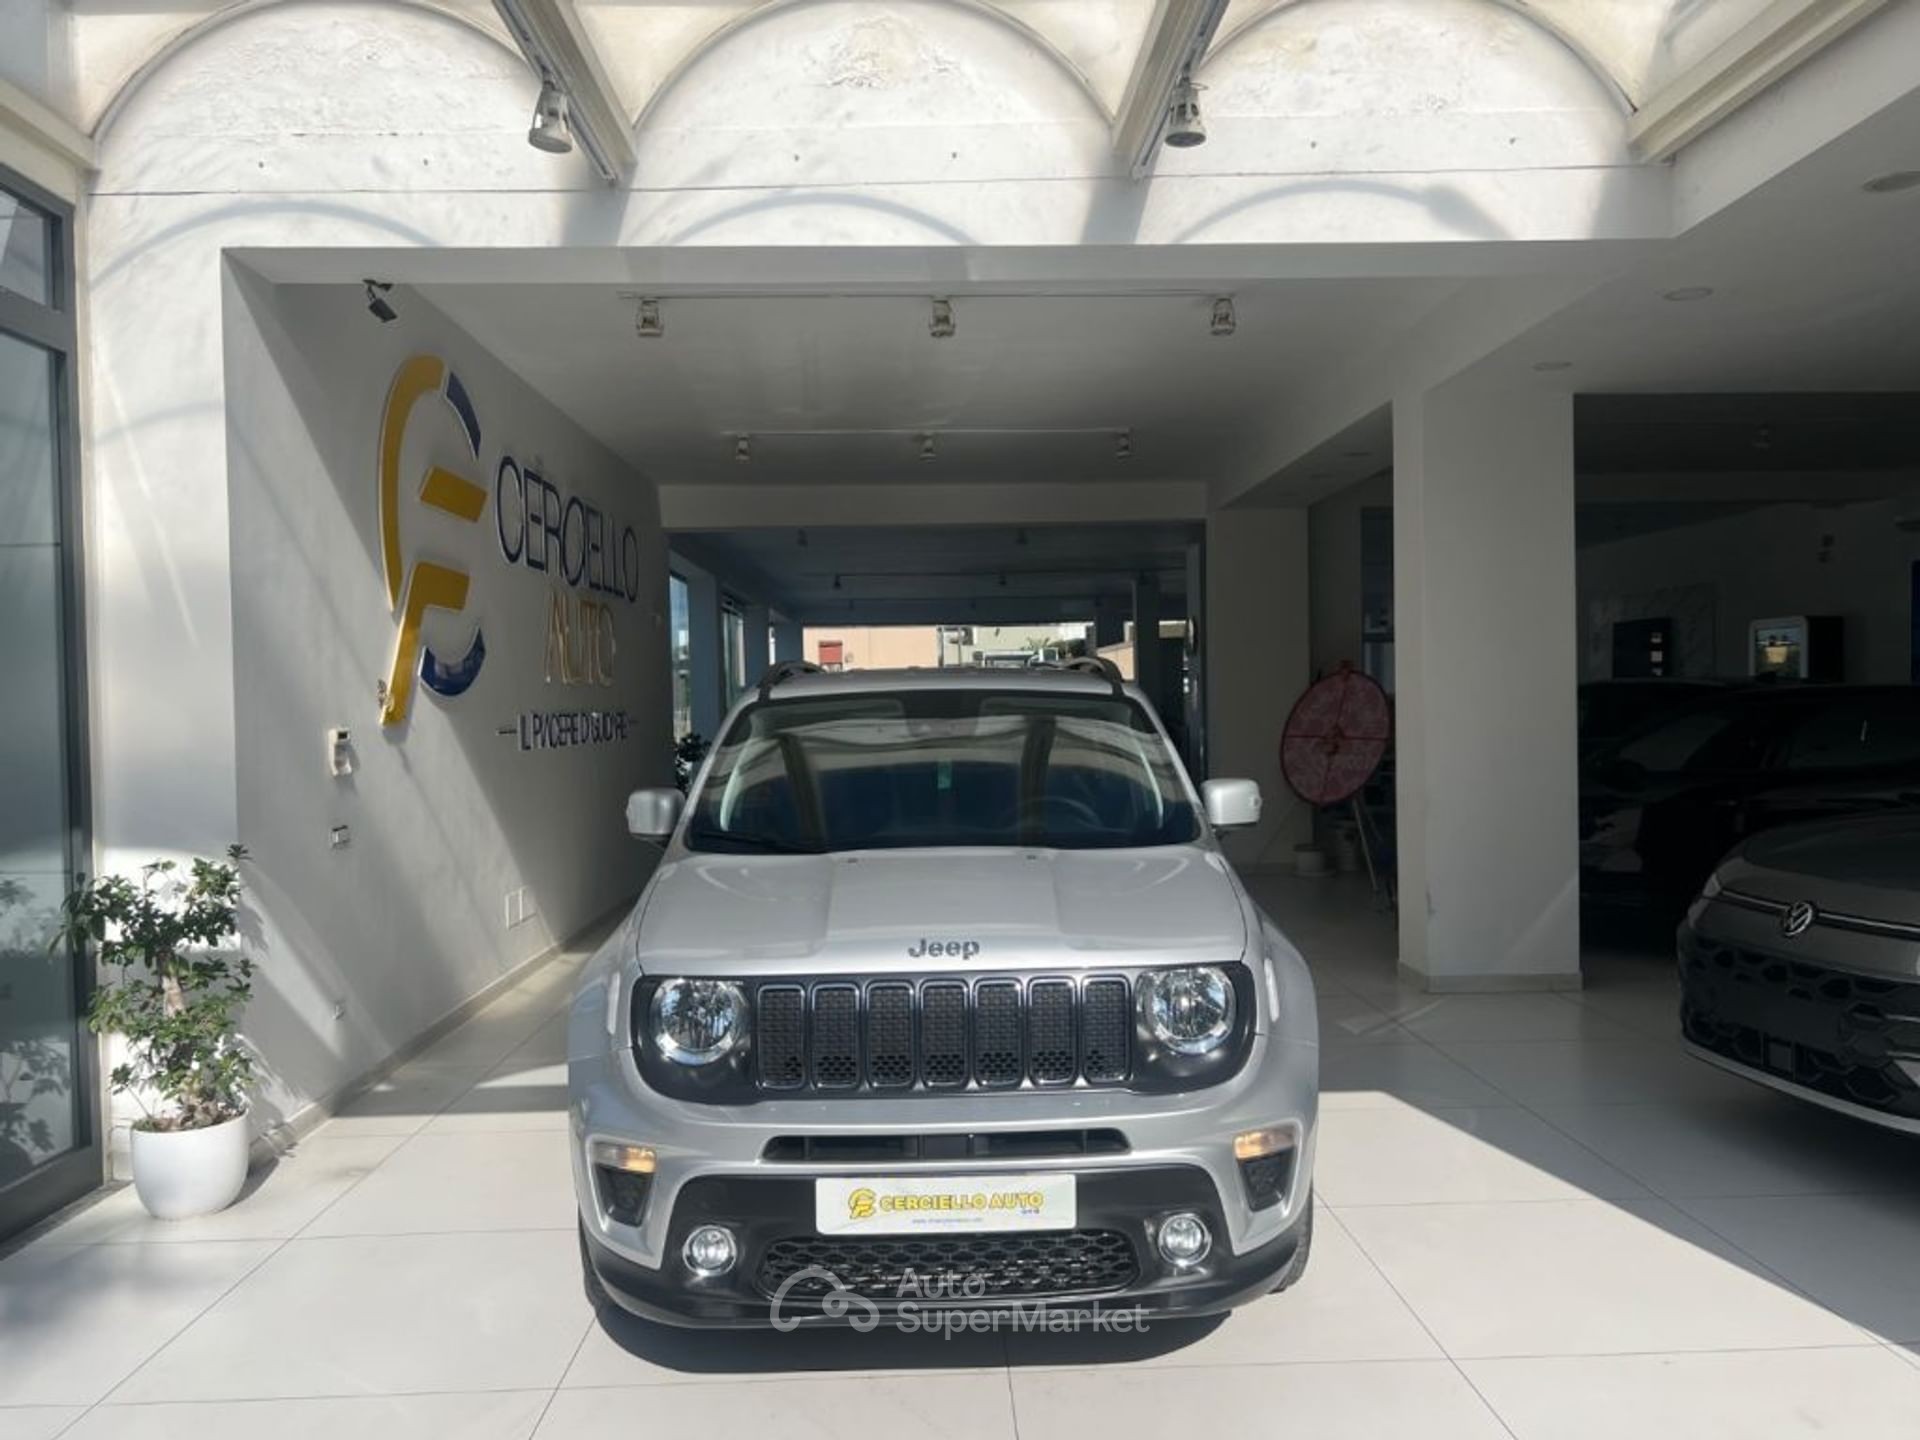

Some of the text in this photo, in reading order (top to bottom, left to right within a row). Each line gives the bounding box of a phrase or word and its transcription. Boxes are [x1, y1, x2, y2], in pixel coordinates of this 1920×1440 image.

[908, 938, 980, 960] Jeep
[880, 1190, 1045, 1212] CERCIELLO AUTO
